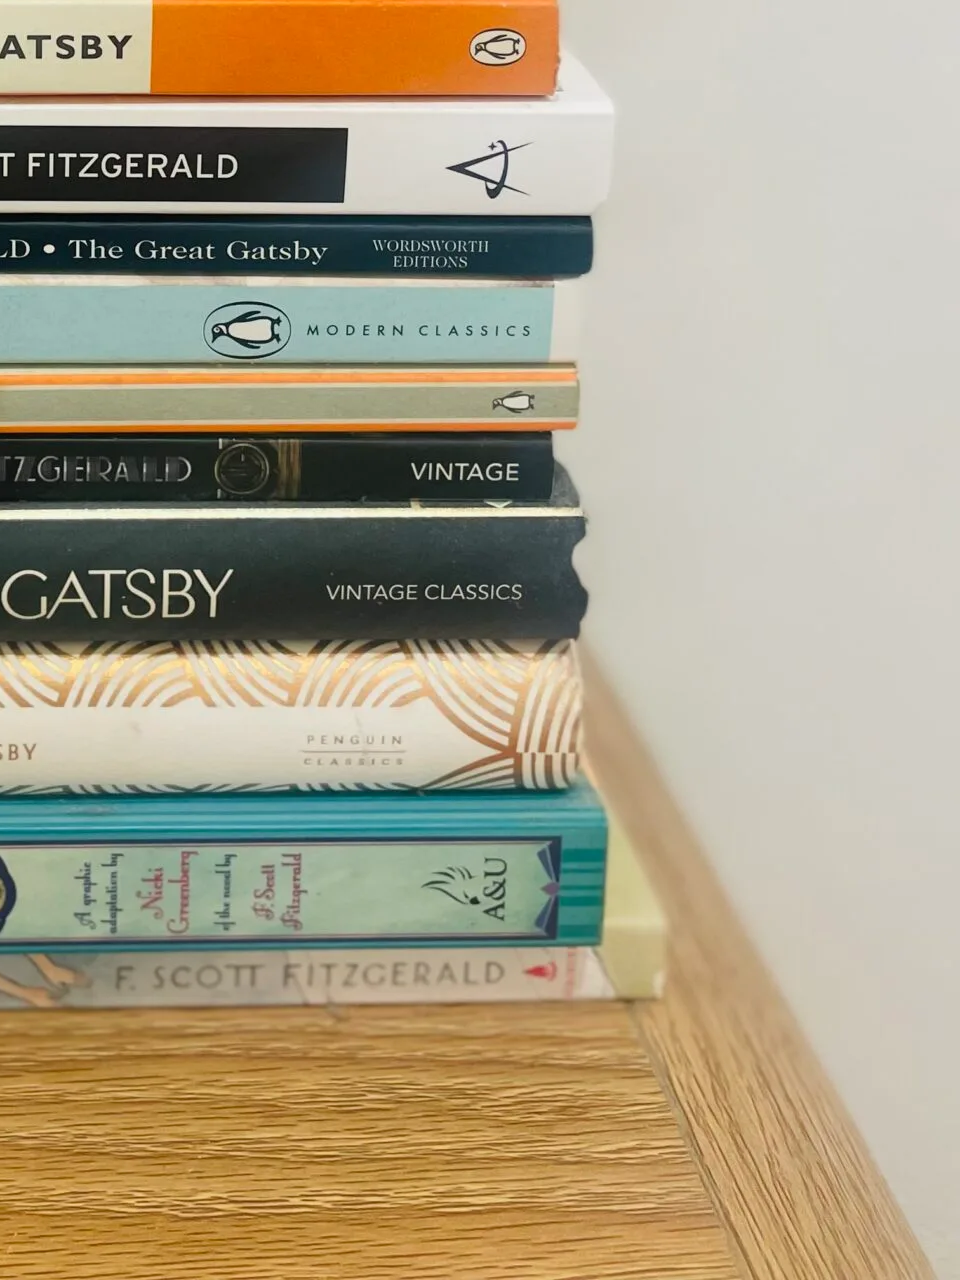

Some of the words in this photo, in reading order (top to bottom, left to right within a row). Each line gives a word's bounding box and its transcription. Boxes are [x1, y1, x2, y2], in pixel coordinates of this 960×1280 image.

[29, 153, 237, 178] FITZGERALD
[69, 240, 122, 258] The
[135, 241, 214, 259] Great
[227, 241, 326, 265] Gatsby
[373, 240, 488, 252] WORDSWORTH
[394, 256, 467, 267] EDITIONS
[307, 325, 403, 336] MODERN
[419, 325, 529, 336] CLASSICS
[411, 463, 519, 481] VINTAGE
[1, 569, 233, 619] GATSBY
[327, 585, 417, 600] VINTAGE
[425, 584, 521, 600] CLASSICS
[304, 733, 404, 747] PENGUIN
[302, 756, 406, 767] CLASSICS
[136, 867, 164, 919] Nicki
[167, 850, 199, 934] Greenberg
[254, 865, 275, 900] Scott
[280, 854, 307, 930] Fitzgerald
[482, 857, 507, 921] A&U
[101, 872, 122, 934] adaptation
[115, 965, 136, 991] F.
[152, 963, 263, 990] SCOTT
[282, 962, 506, 990] FITZGERALD
